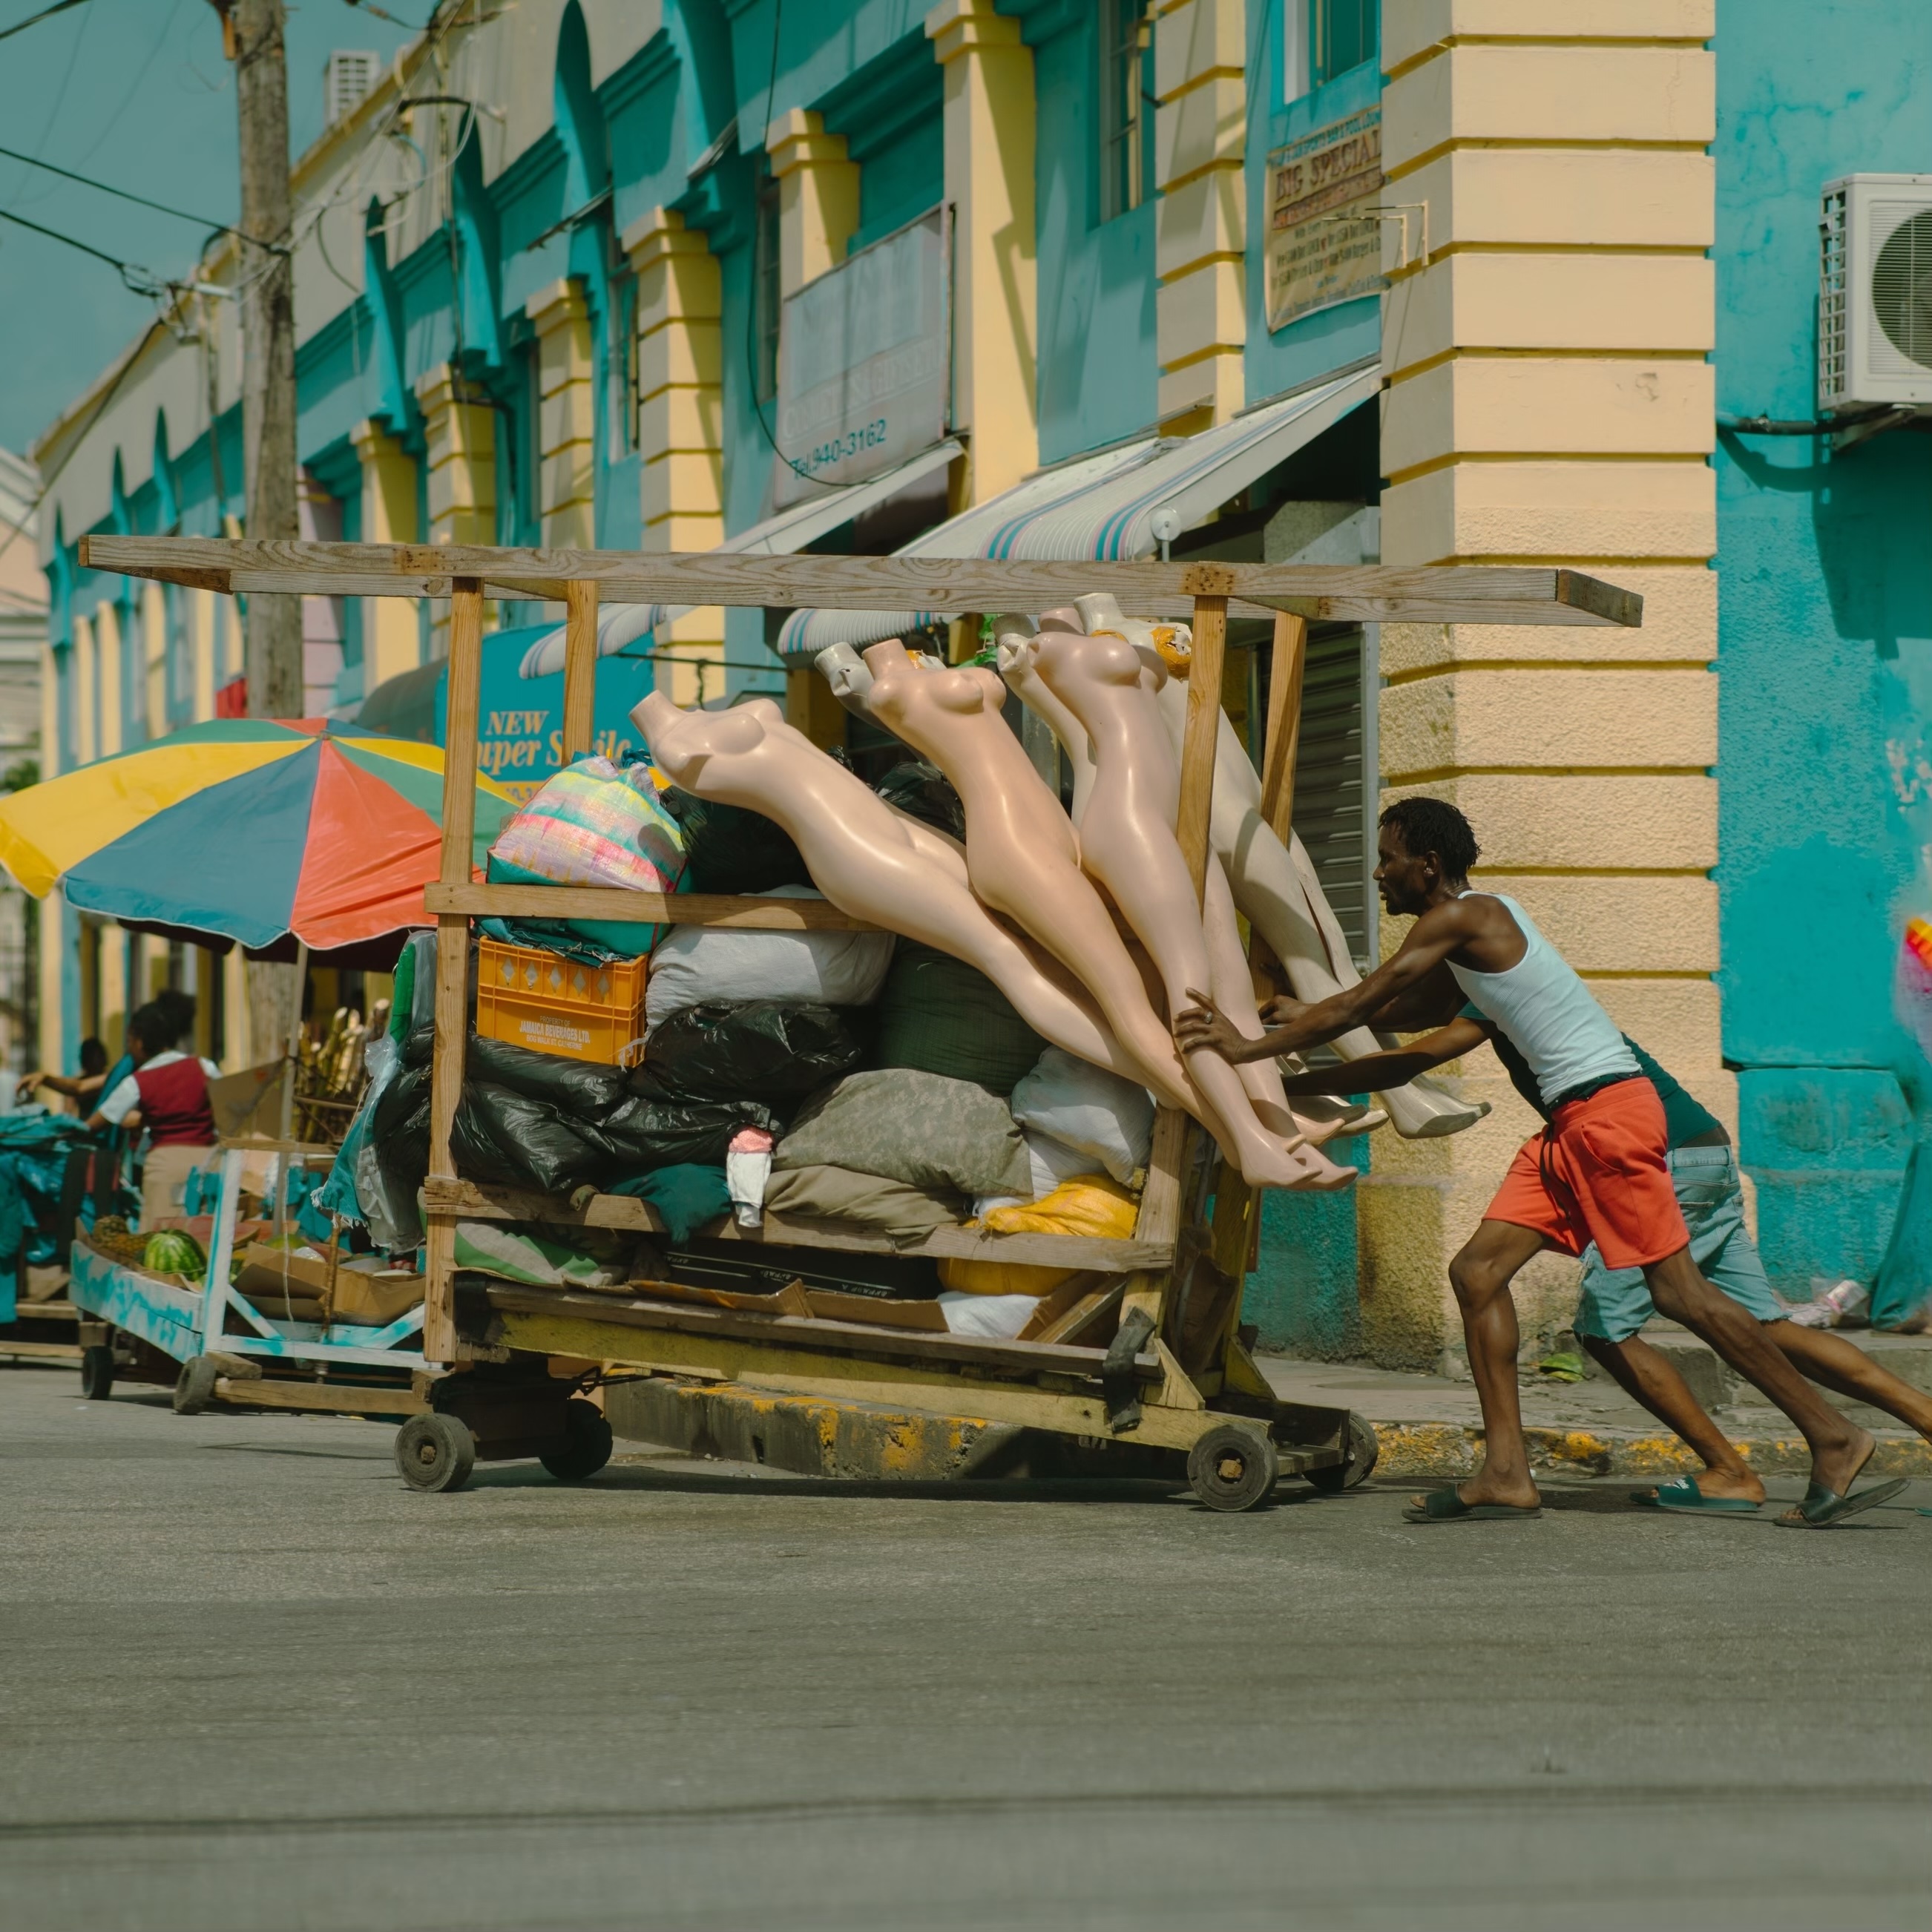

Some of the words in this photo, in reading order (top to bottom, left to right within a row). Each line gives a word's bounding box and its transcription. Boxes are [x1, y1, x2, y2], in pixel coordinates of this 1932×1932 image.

[1276, 165, 1303, 203] BIG
[485, 710, 550, 735] NEW
[478, 740, 542, 775] uper
[545, 729, 631, 766] Sile
[520, 1020, 544, 1035] JAMAICA
[545, 1024, 577, 1041] BEVERAGES
[579, 1030, 591, 1044] LTD.
[540, 1016, 564, 1025] PROPERTY
[526, 1034, 536, 1043] BOG
[537, 1036, 551, 1045] WALK
[558, 1039, 582, 1051] CATHERINE
